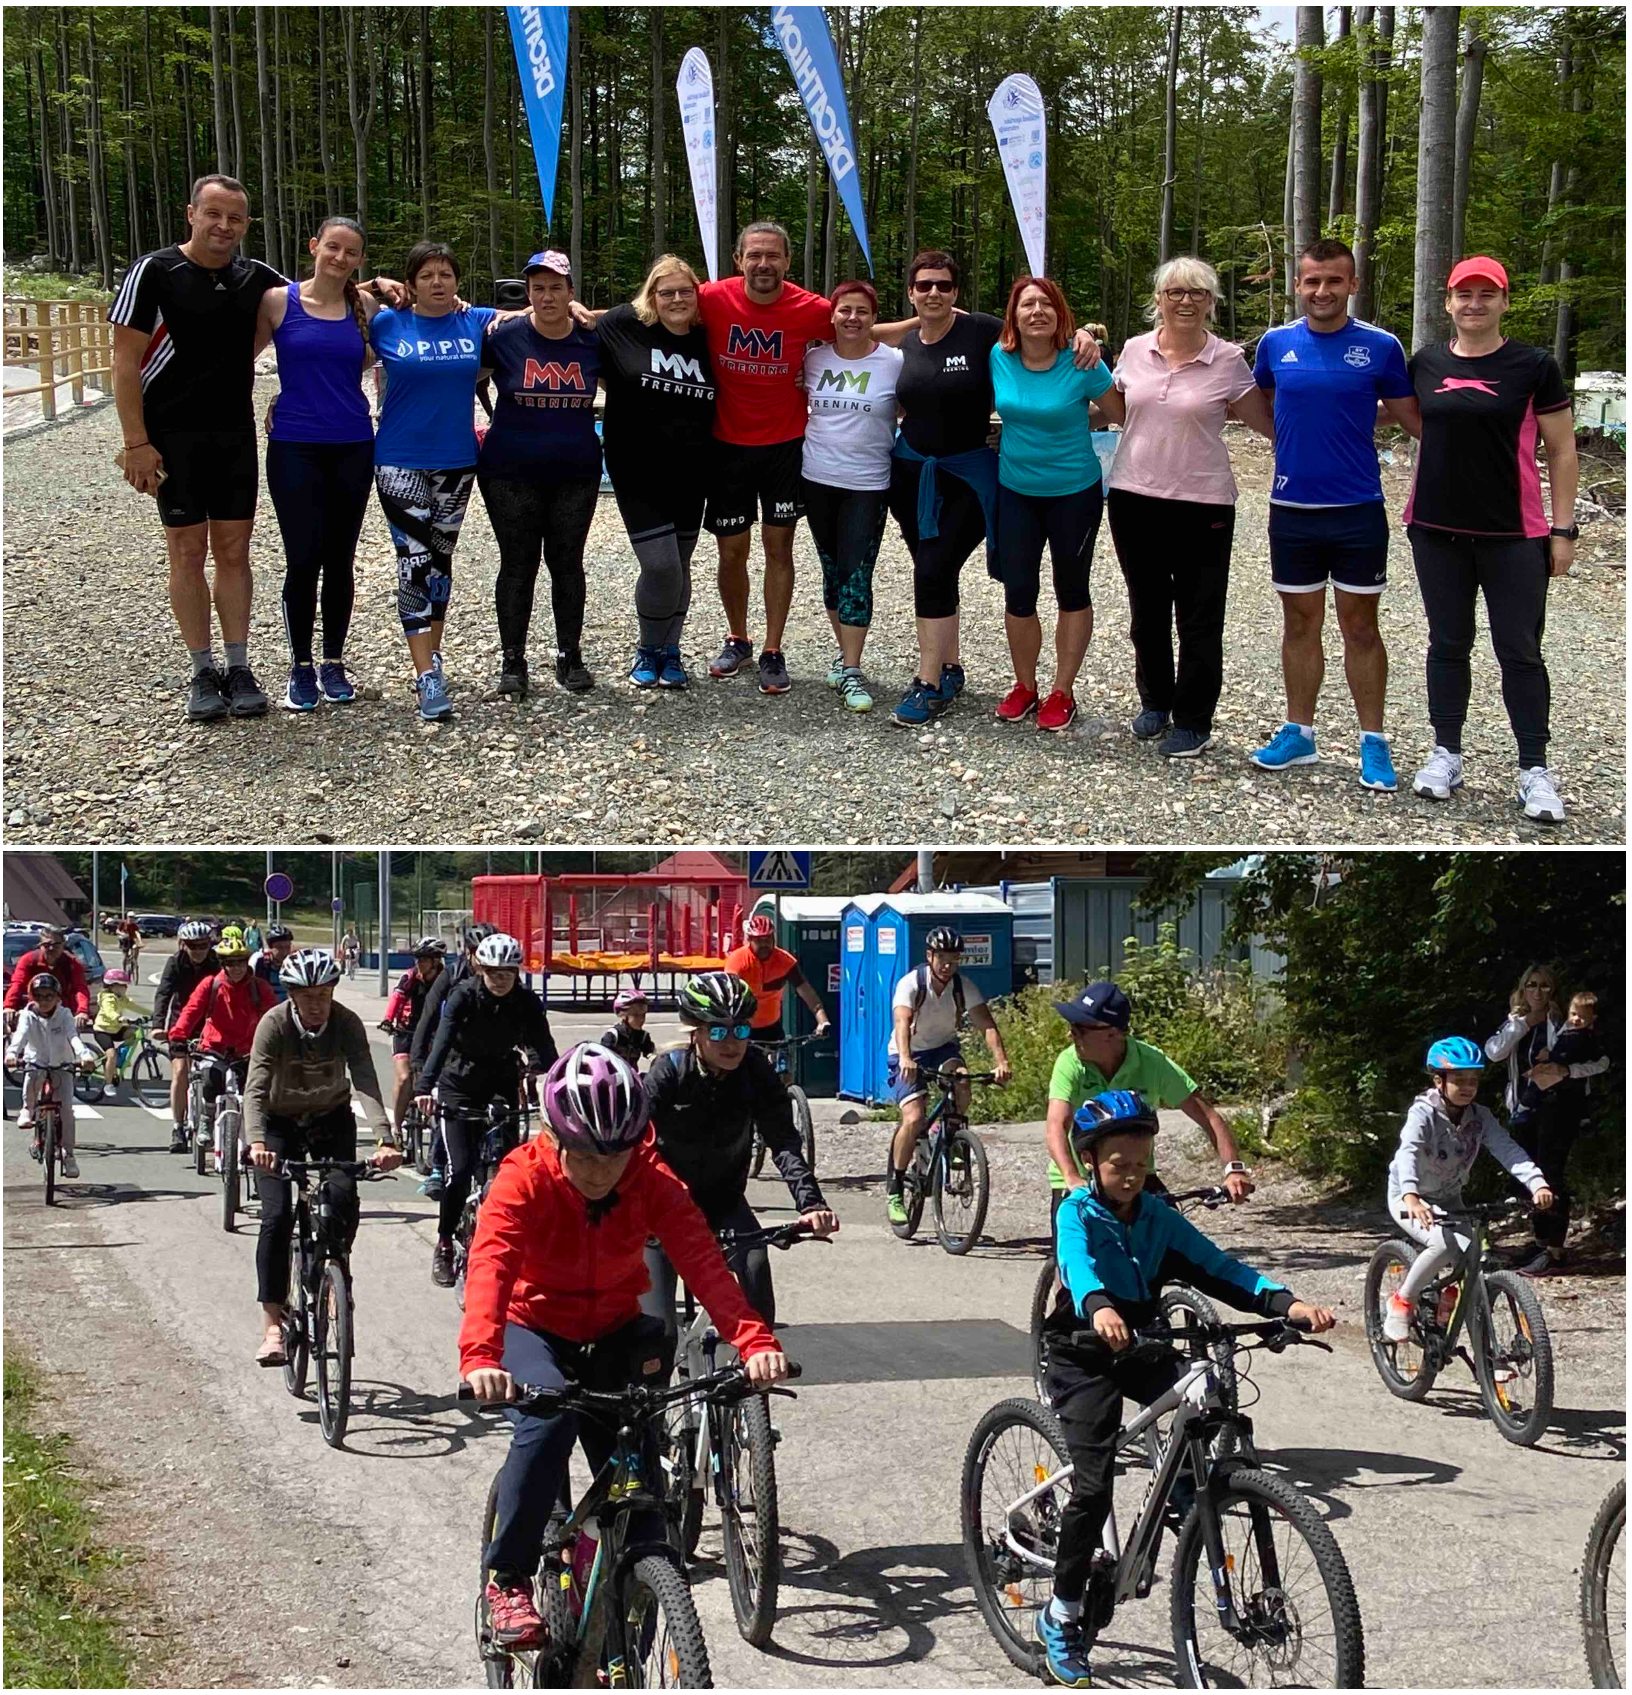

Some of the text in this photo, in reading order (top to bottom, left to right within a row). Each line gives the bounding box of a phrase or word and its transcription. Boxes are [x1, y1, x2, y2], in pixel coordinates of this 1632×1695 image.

[727, 324, 784, 360] MM
[523, 358, 586, 390] MM
[651, 348, 706, 383] MM
[946, 355, 966, 367] MM
[640, 377, 714, 400] TRENING
[816, 369, 872, 394] MM
